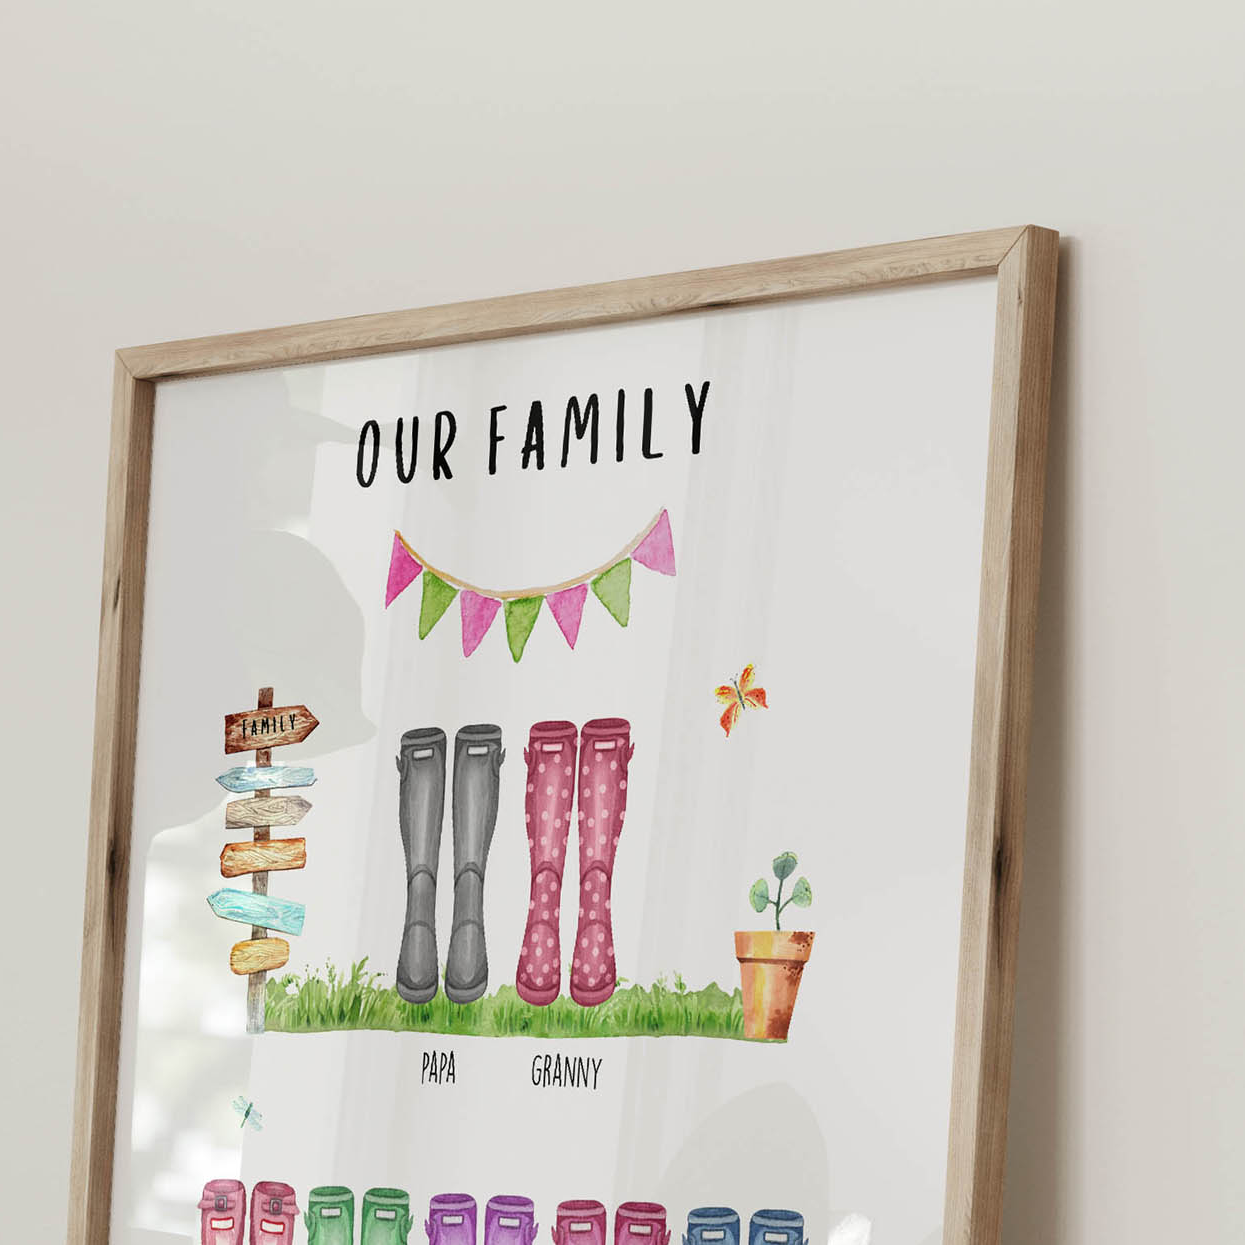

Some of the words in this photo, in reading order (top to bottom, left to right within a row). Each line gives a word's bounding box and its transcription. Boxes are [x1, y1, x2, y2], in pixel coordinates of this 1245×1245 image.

[356, 411, 457, 488] OUR
[489, 381, 710, 475] FAMILY
[242, 714, 296, 739] FAMILY
[422, 1050, 455, 1084] PAPA
[532, 1053, 602, 1090] GRANNY
